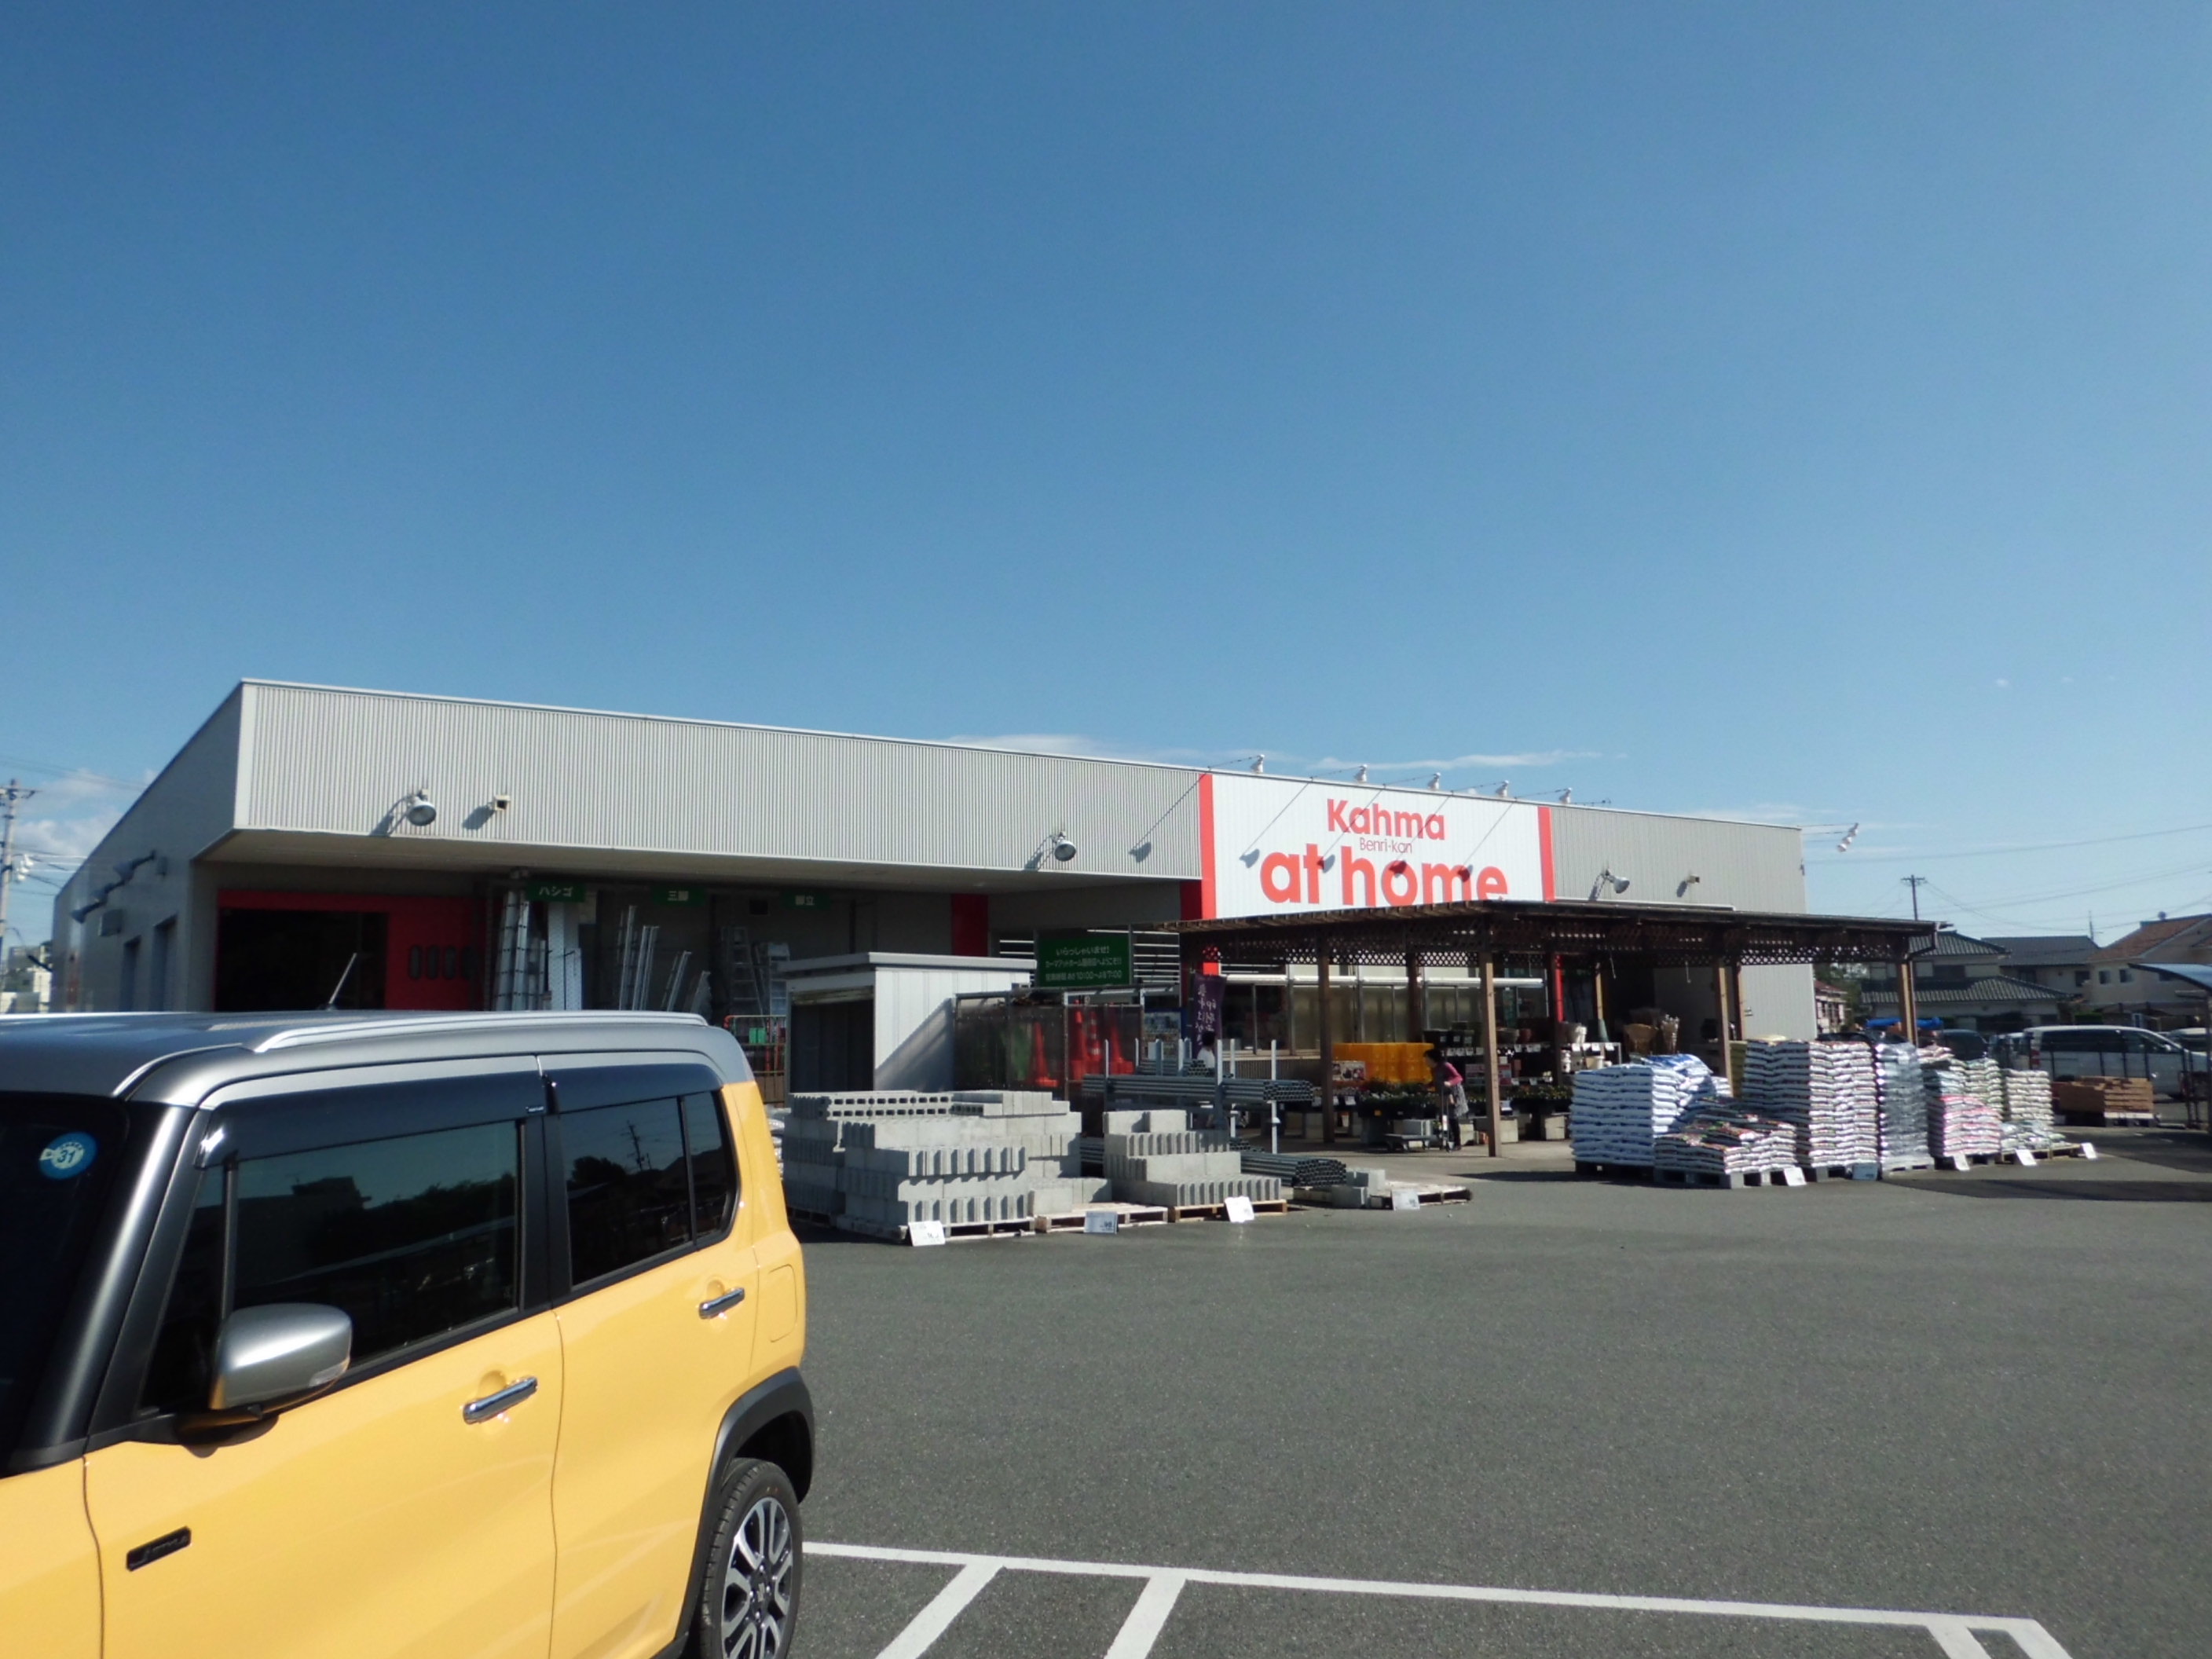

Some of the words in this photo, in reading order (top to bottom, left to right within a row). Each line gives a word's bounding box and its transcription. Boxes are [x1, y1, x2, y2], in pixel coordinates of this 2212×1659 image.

[1328, 799, 1445, 840] Kahma
[1360, 837, 1412, 854] Benri-kan
[1260, 843, 1324, 904] at
[1342, 846, 1507, 906] home
[539, 886, 573, 897] ハシゴ
[57, 1150, 75, 1163] 31
